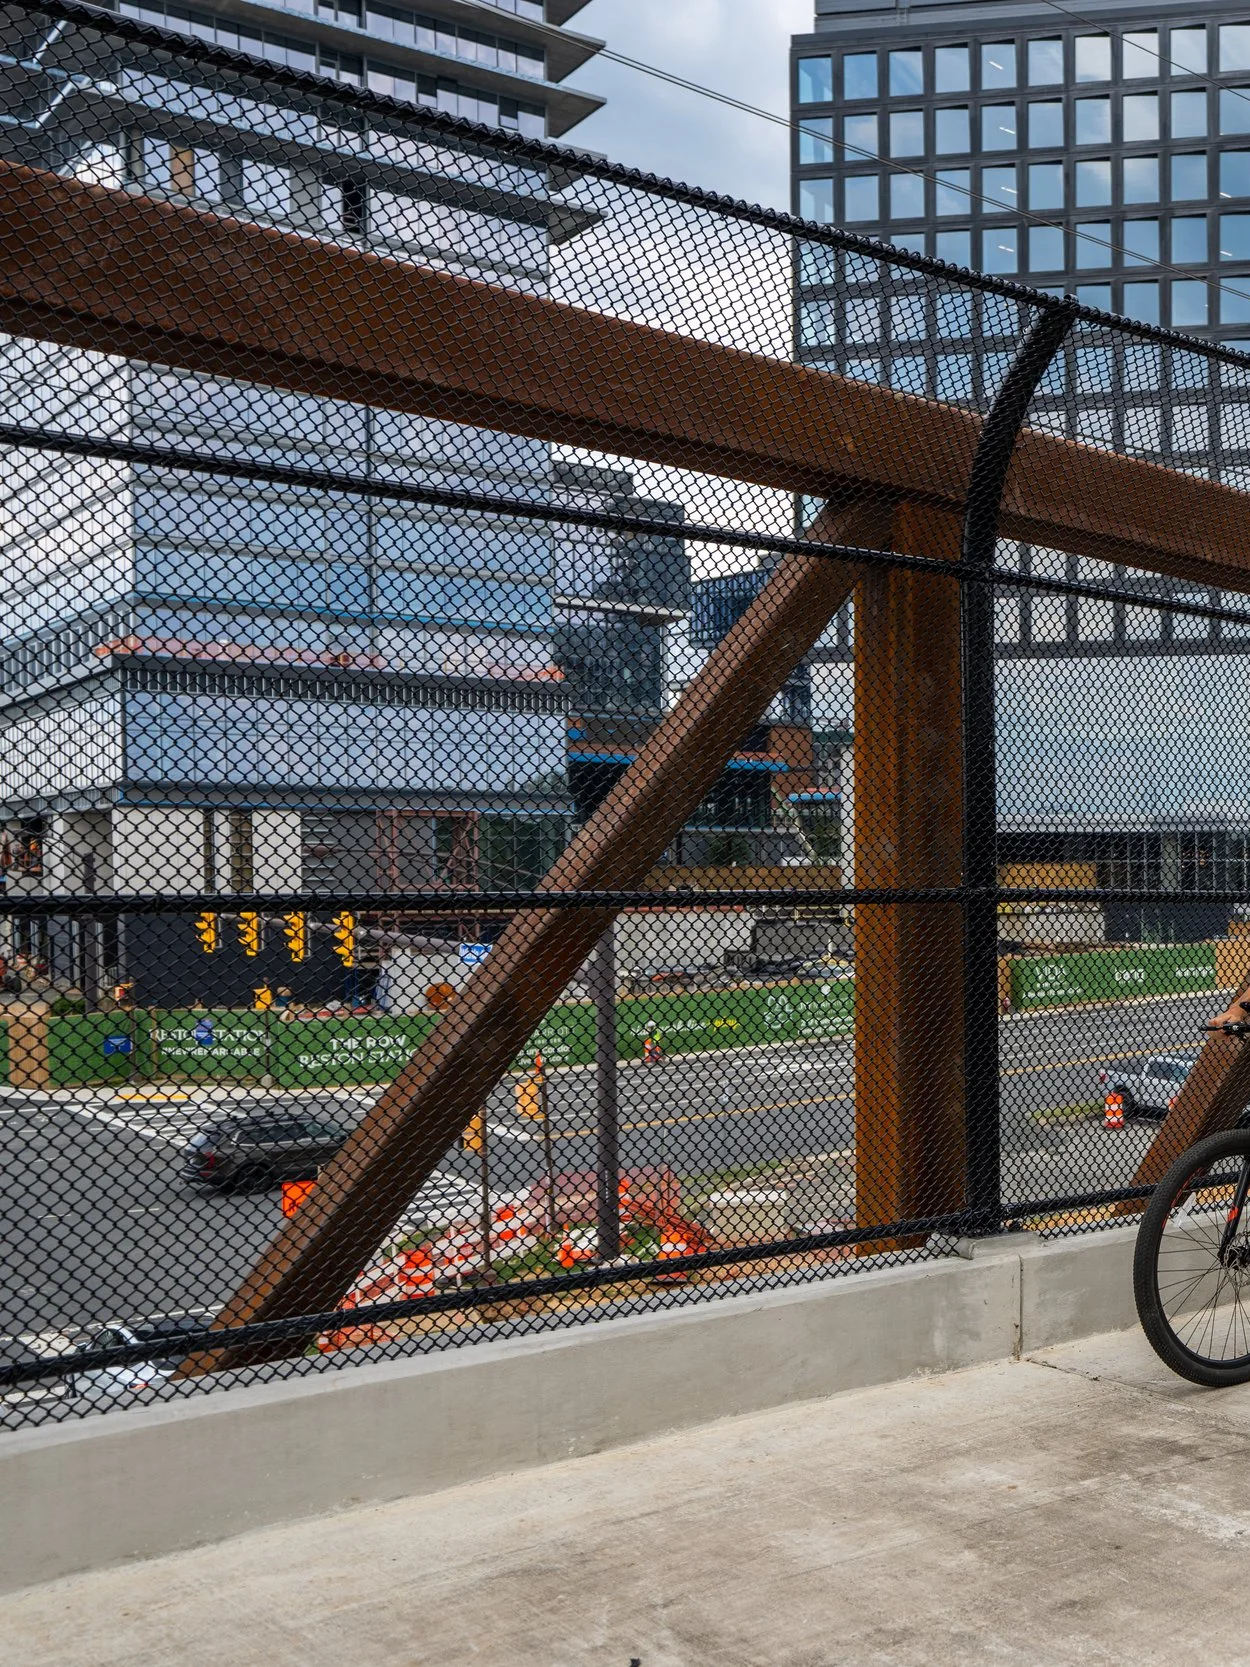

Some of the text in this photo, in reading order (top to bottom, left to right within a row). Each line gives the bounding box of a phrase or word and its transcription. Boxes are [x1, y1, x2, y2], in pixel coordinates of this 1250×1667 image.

[148, 1029, 200, 1042] RESTO
[329, 1033, 407, 1050] THE ROW
[299, 1048, 418, 1069] RESTON STATI
